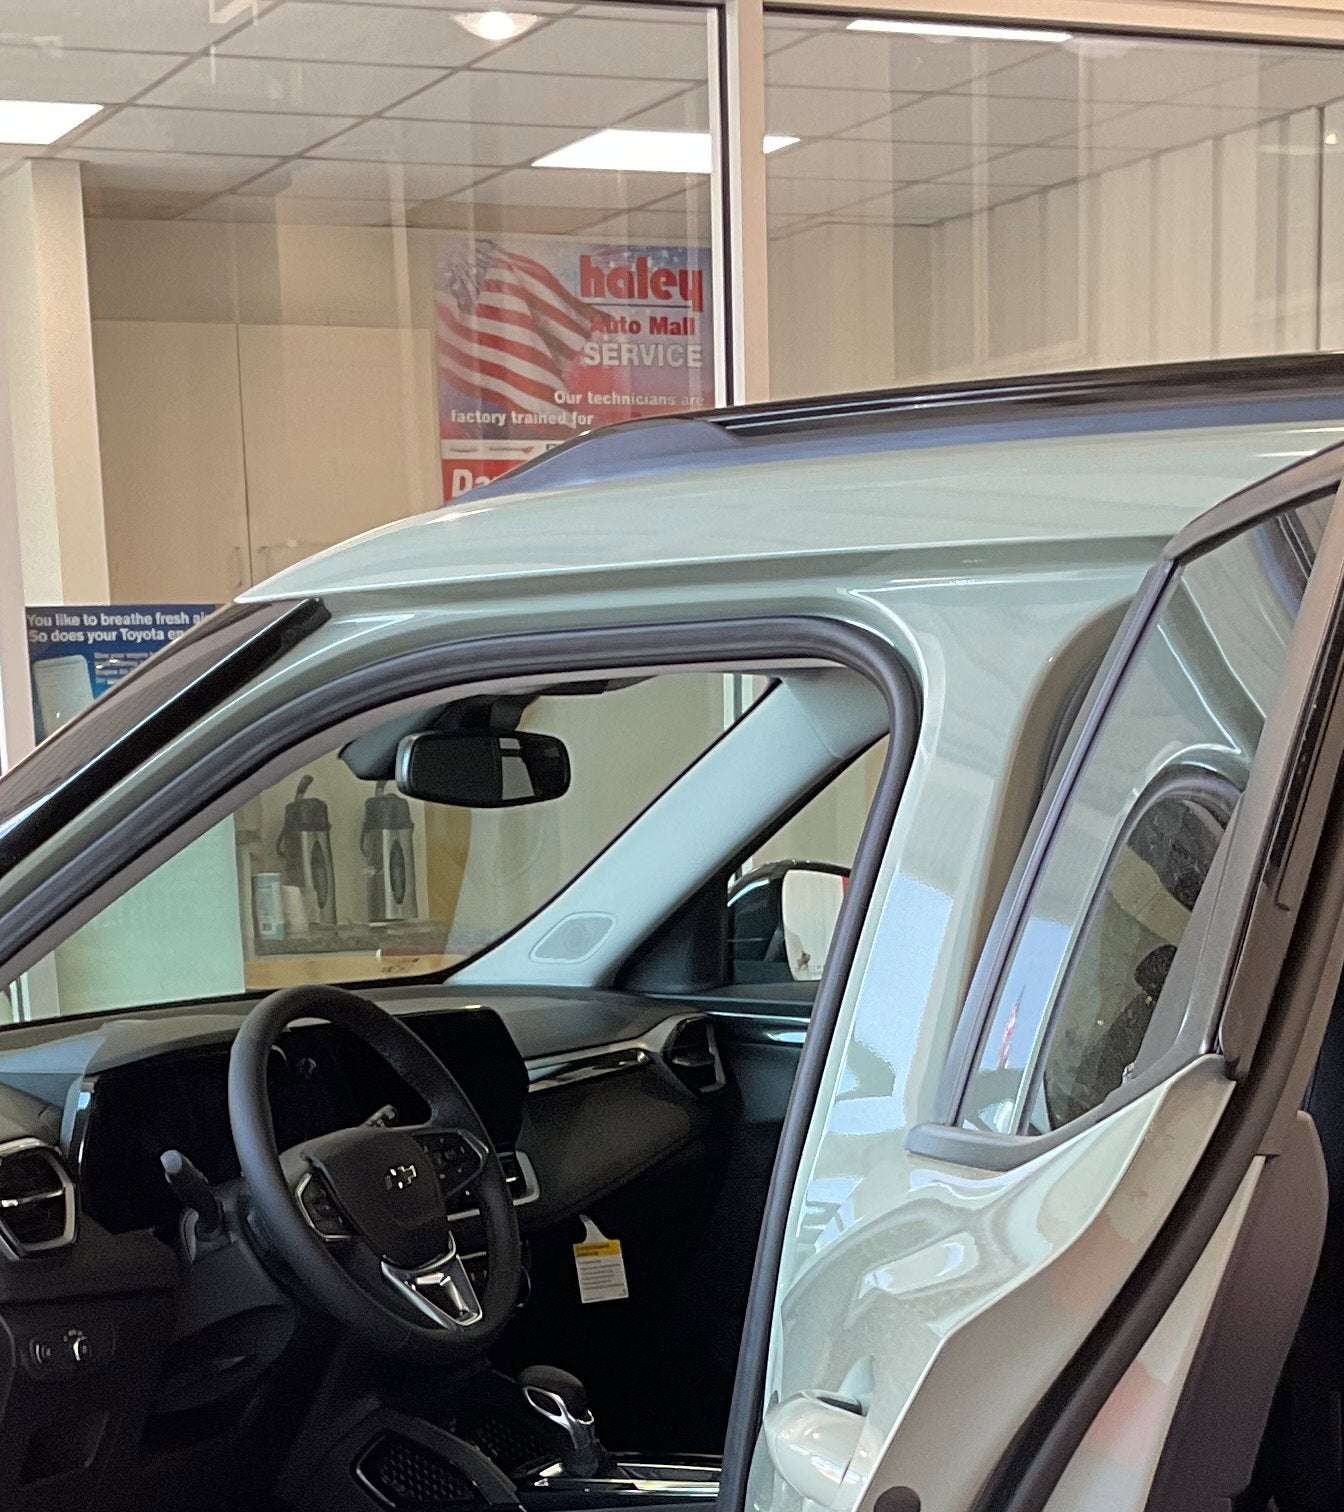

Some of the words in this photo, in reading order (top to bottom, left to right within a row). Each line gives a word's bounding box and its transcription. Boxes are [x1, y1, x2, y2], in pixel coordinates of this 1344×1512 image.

[579, 254, 703, 312] haley
[591, 316, 641, 335] Auto
[649, 316, 695, 336] Mall
[582, 341, 703, 368] SERVICE
[554, 390, 582, 405] Our
[587, 391, 675, 406] technicians
[680, 396, 704, 406] are
[451, 409, 506, 427] factory
[511, 410, 566, 425] trained
[572, 411, 594, 425] for
[27, 613, 52, 627] You
[55, 612, 81, 627] like
[83, 613, 98, 626] to
[100, 612, 153, 627] breathe
[155, 611, 190, 625] fresh
[28, 629, 48, 642] So
[51, 629, 85, 642] does
[87, 631, 117, 645] your
[119, 627, 165, 643] Toyota
